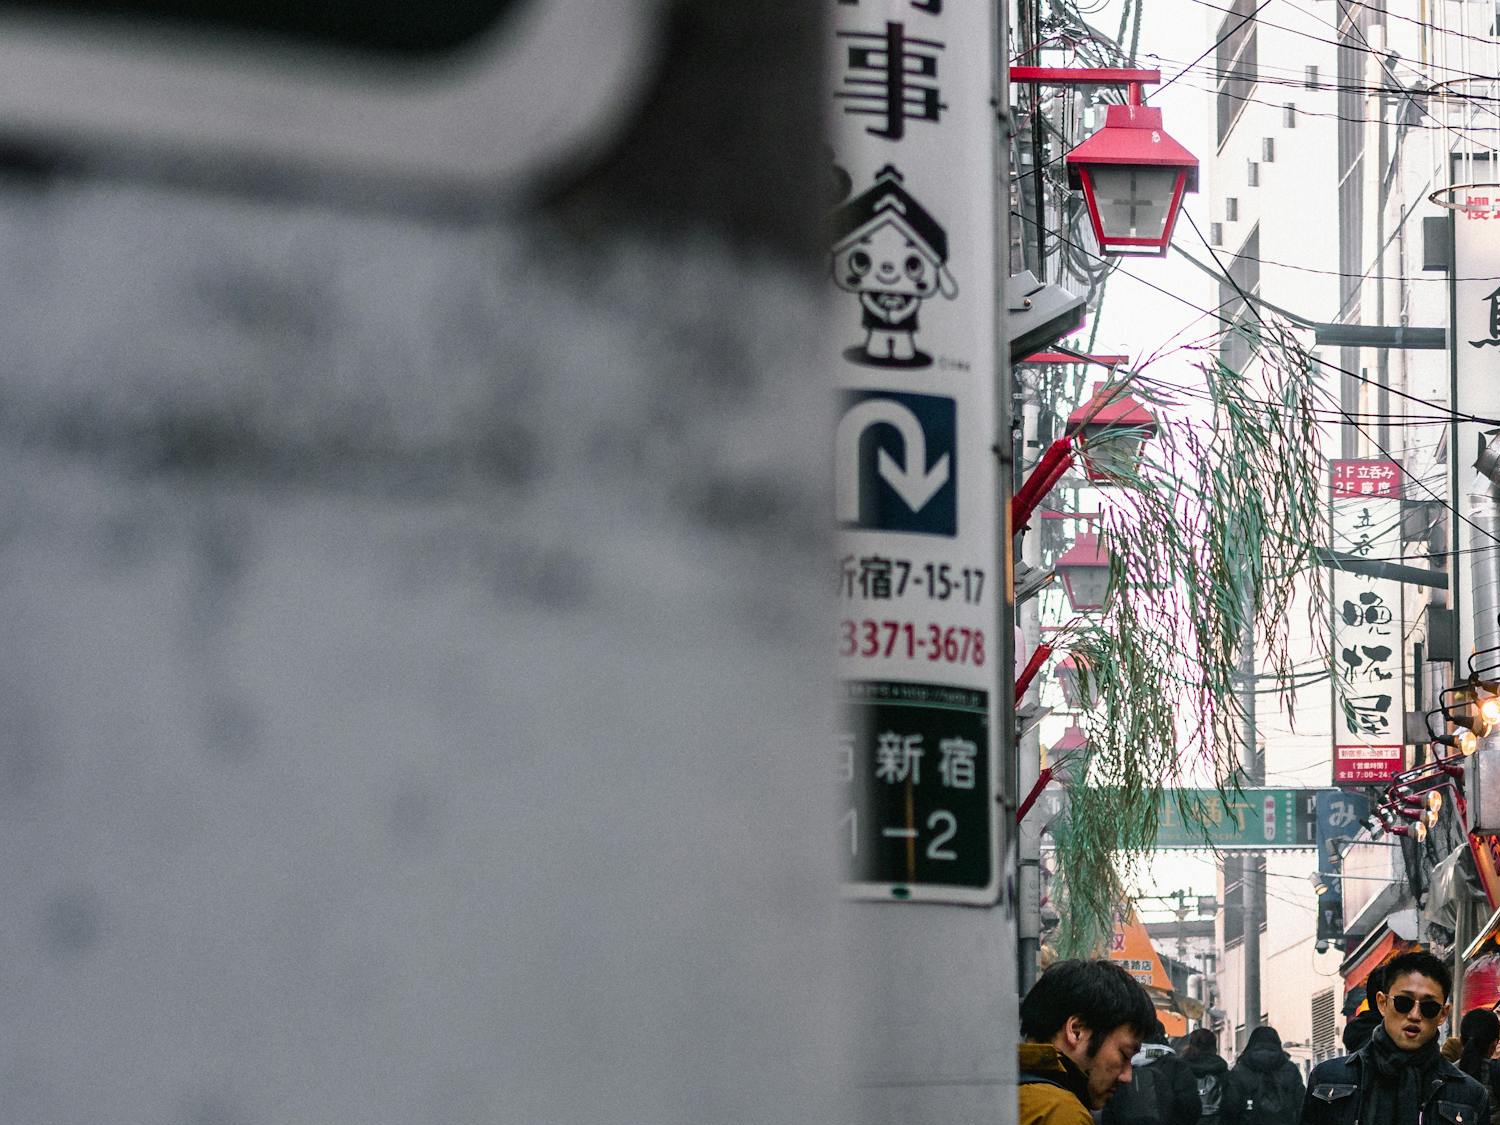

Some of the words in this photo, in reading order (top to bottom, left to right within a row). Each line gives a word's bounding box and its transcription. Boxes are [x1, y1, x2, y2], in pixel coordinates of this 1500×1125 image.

[834, 0, 948, 139] 事
[1336, 466, 1354, 478] 1F
[1357, 465, 1394, 479] 立呑み
[1336, 482, 1354, 494] 2F
